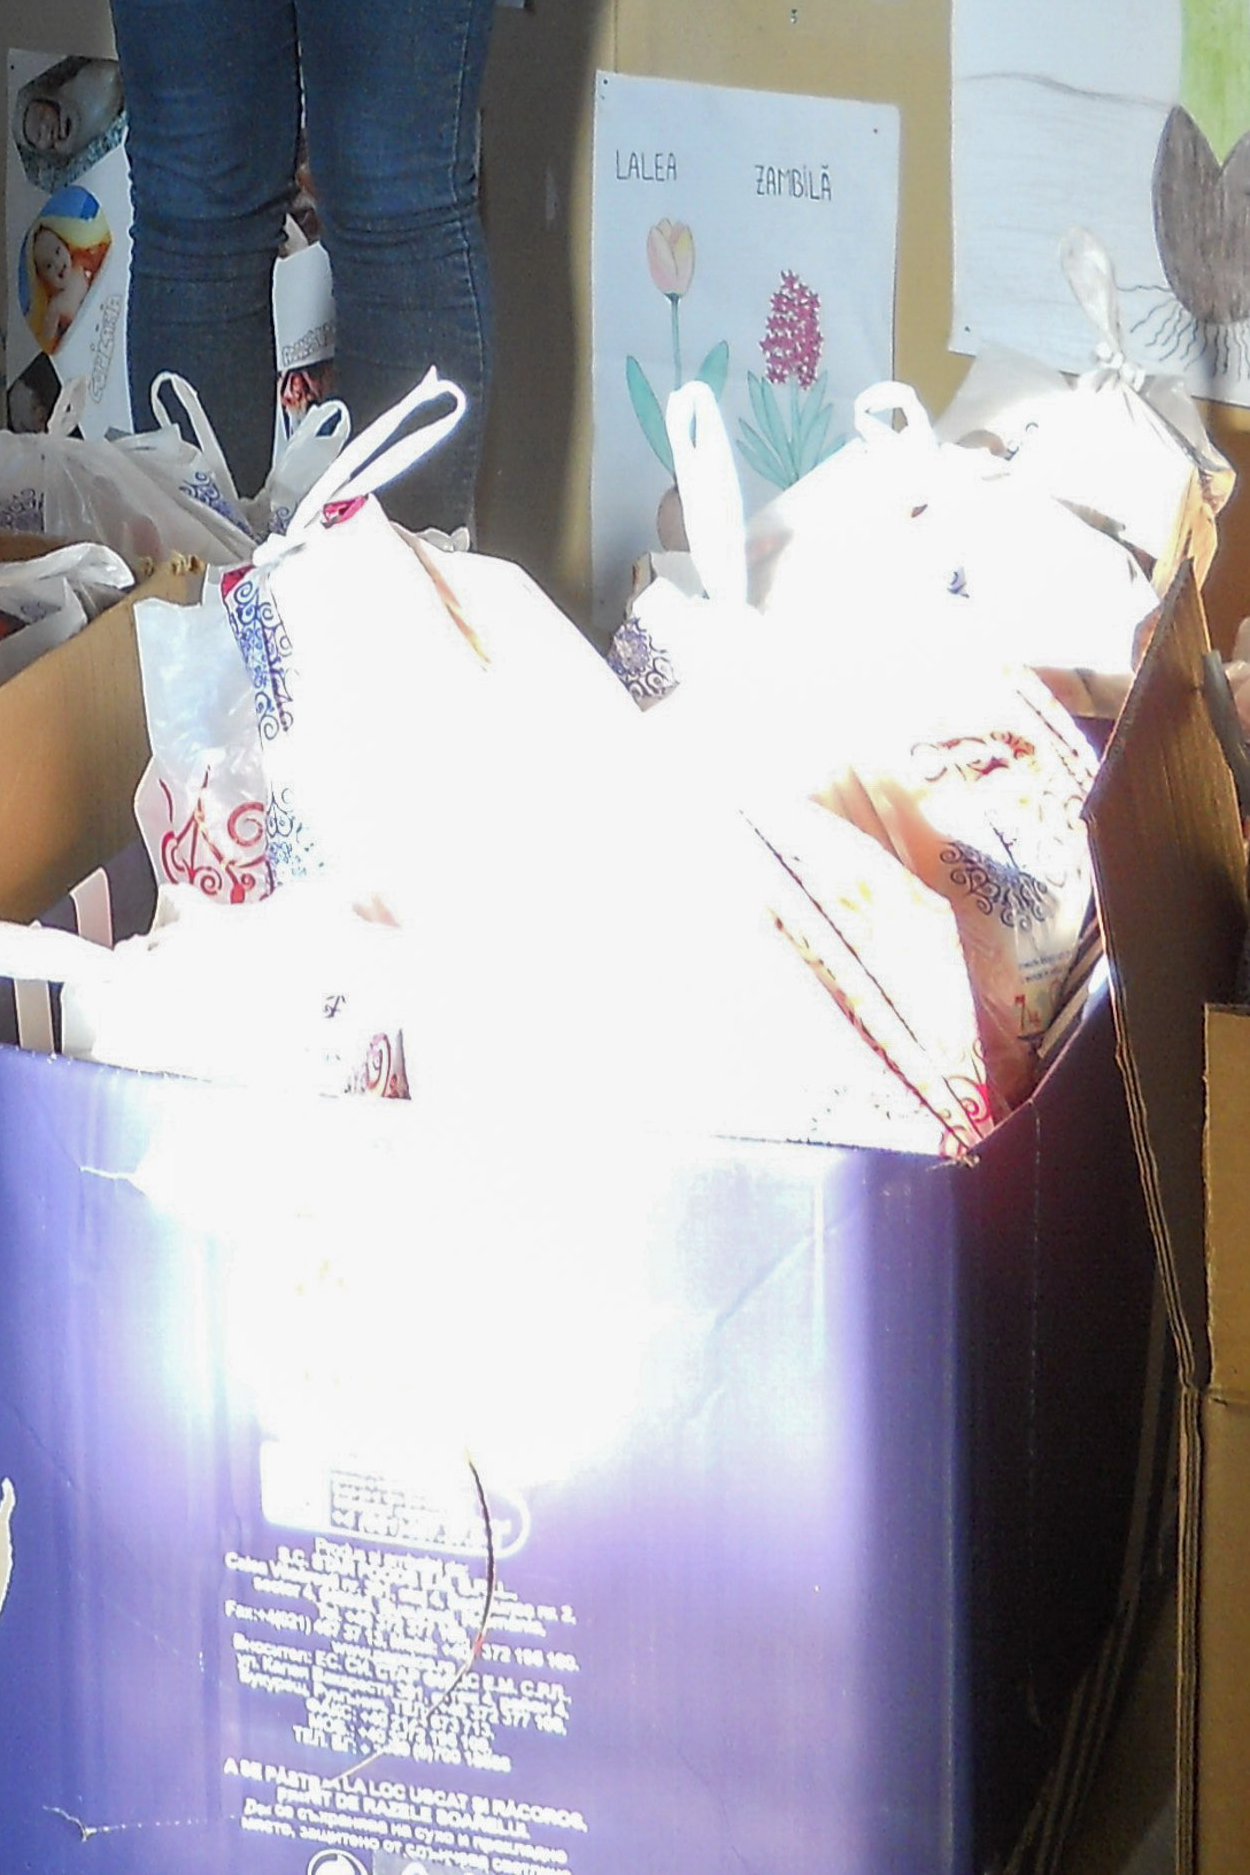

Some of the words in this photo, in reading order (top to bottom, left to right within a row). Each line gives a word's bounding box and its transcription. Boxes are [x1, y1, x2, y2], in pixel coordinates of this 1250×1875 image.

[616, 149, 677, 182] LALEA
[224, 1757, 238, 1776] A
[343, 1776, 366, 1795] LA
[370, 1779, 405, 1801] LOC
[336, 1792, 359, 1812] DE
